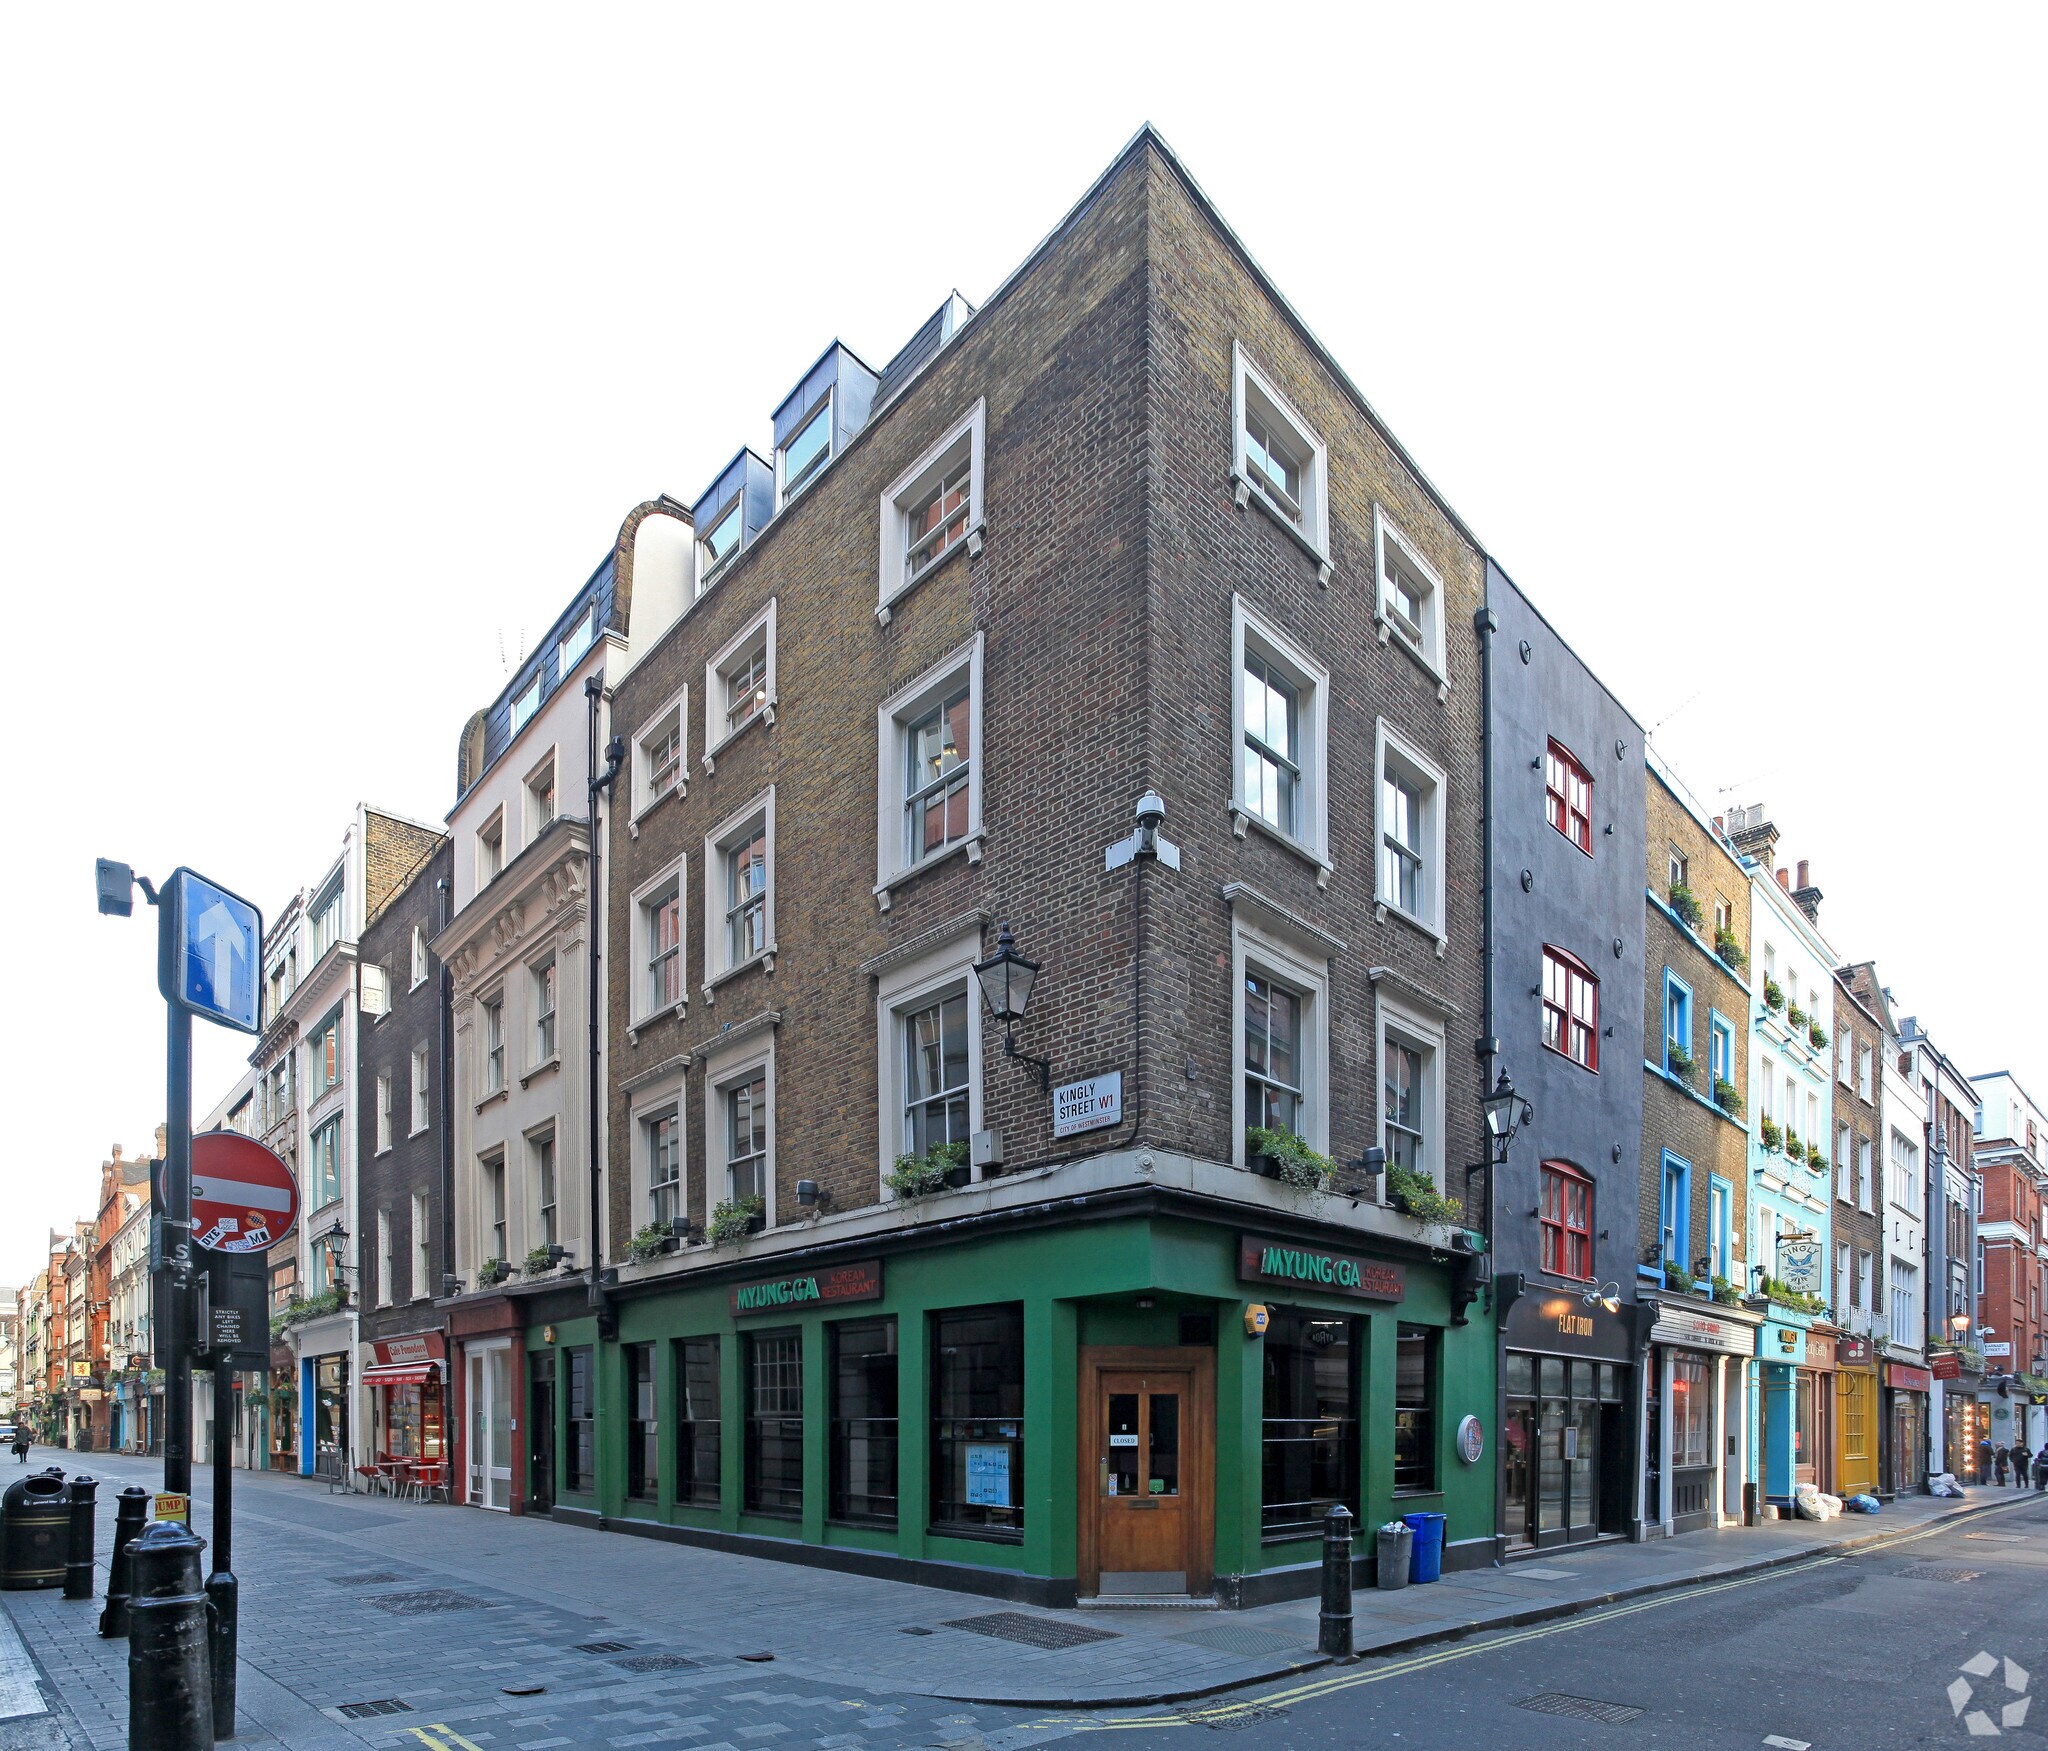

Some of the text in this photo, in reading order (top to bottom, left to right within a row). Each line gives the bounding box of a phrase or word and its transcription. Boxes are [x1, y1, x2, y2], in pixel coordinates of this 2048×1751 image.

[1059, 1082, 1096, 1105] KINGLY
[1059, 1094, 1113, 1120] STREET W1
[1060, 1115, 1111, 1134] CITY OF WESTMINSTER
[201, 1228, 221, 1246] DYE
[1781, 1245, 1819, 1258] KINGLY
[831, 1269, 865, 1284] KOREAN
[1262, 1247, 1332, 1284] MYUNG
[1334, 1259, 1361, 1288] GA
[1365, 1265, 1396, 1281] KOREAN
[737, 1277, 820, 1310] MYUNG GA
[822, 1279, 877, 1299] RESTAURANT
[1558, 1313, 1593, 1337] FLAT IRON
[223, 1353, 232, 1363] 2
[400, 1343, 426, 1355] Pomodoro
